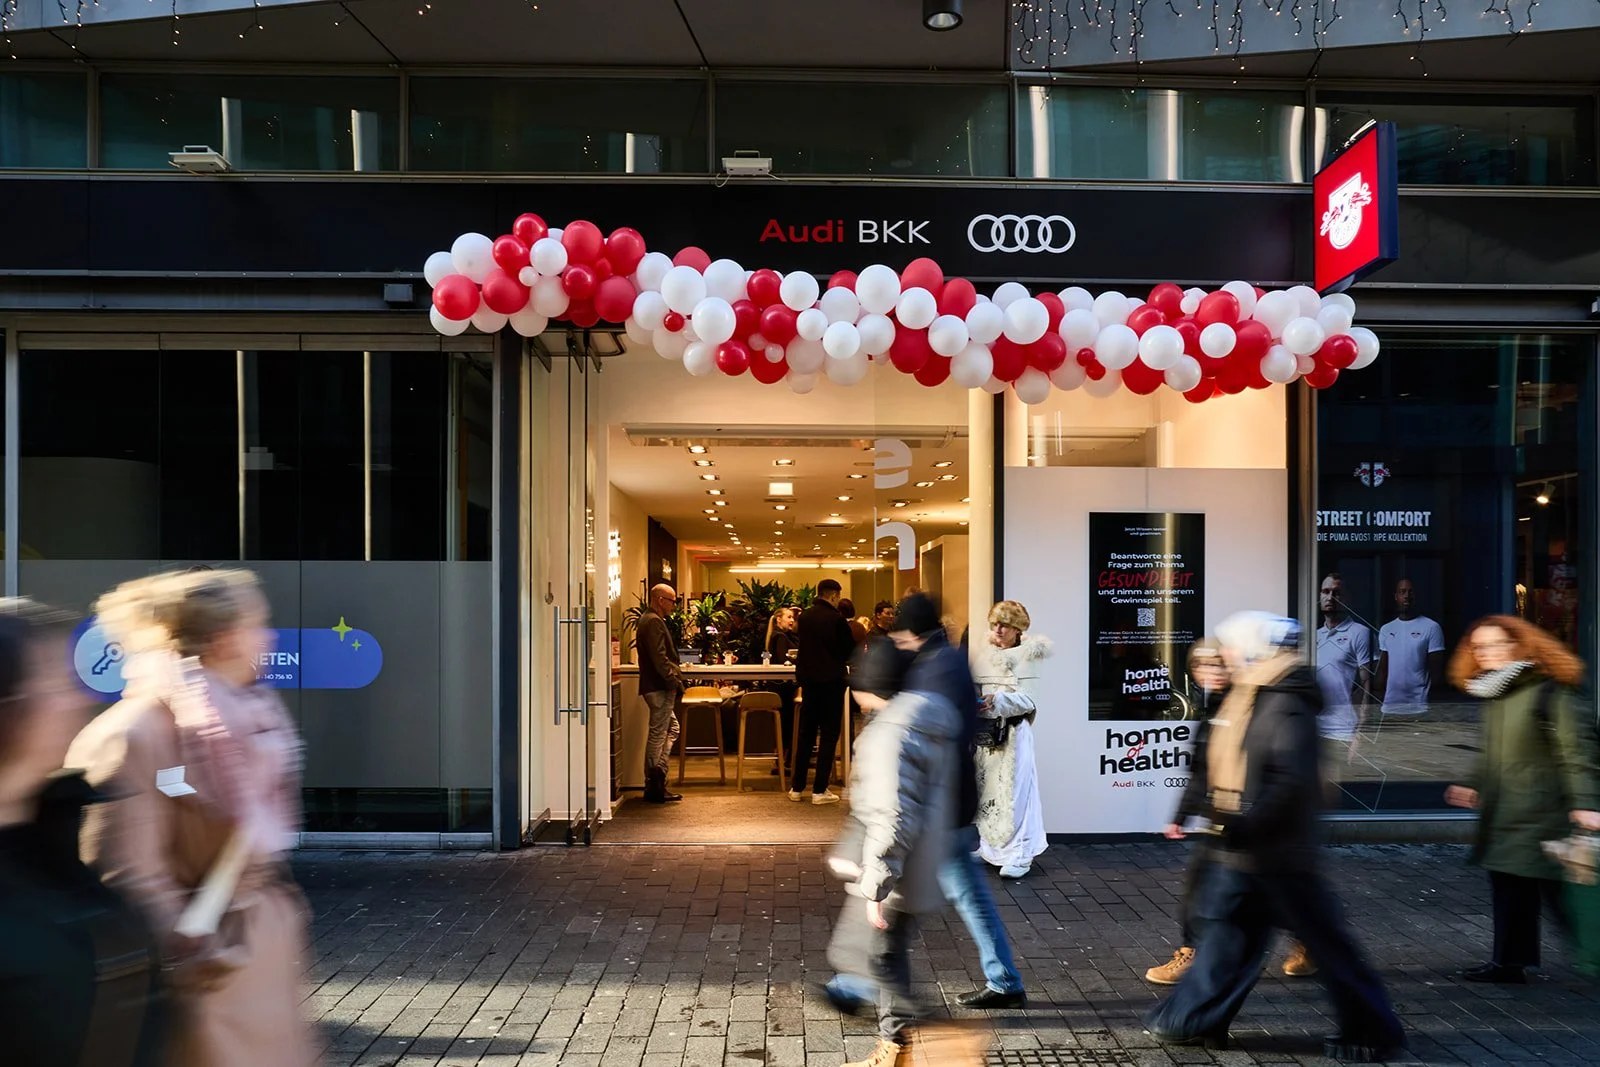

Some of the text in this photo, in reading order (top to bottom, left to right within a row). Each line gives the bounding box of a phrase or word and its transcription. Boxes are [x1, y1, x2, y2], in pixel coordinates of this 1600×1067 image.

[759, 219, 931, 243] Audi BKK
[1316, 510, 1363, 526] STREET
[1316, 533, 1328, 541] DIE
[1329, 533, 1349, 541] PUMA
[1388, 533, 1428, 541] KOLLEKTION
[1110, 552, 1182, 560] Beantworte eine
[1108, 561, 1132, 569] Frage
[1098, 570, 1194, 588] GESUNDHEIT
[1110, 597, 1163, 605] Gewinnspiel
[1125, 667, 1169, 680] home
[1122, 679, 1170, 694] health
[1106, 725, 1190, 749] home
[1127, 739, 1145, 758] of
[1100, 747, 1191, 775] health
